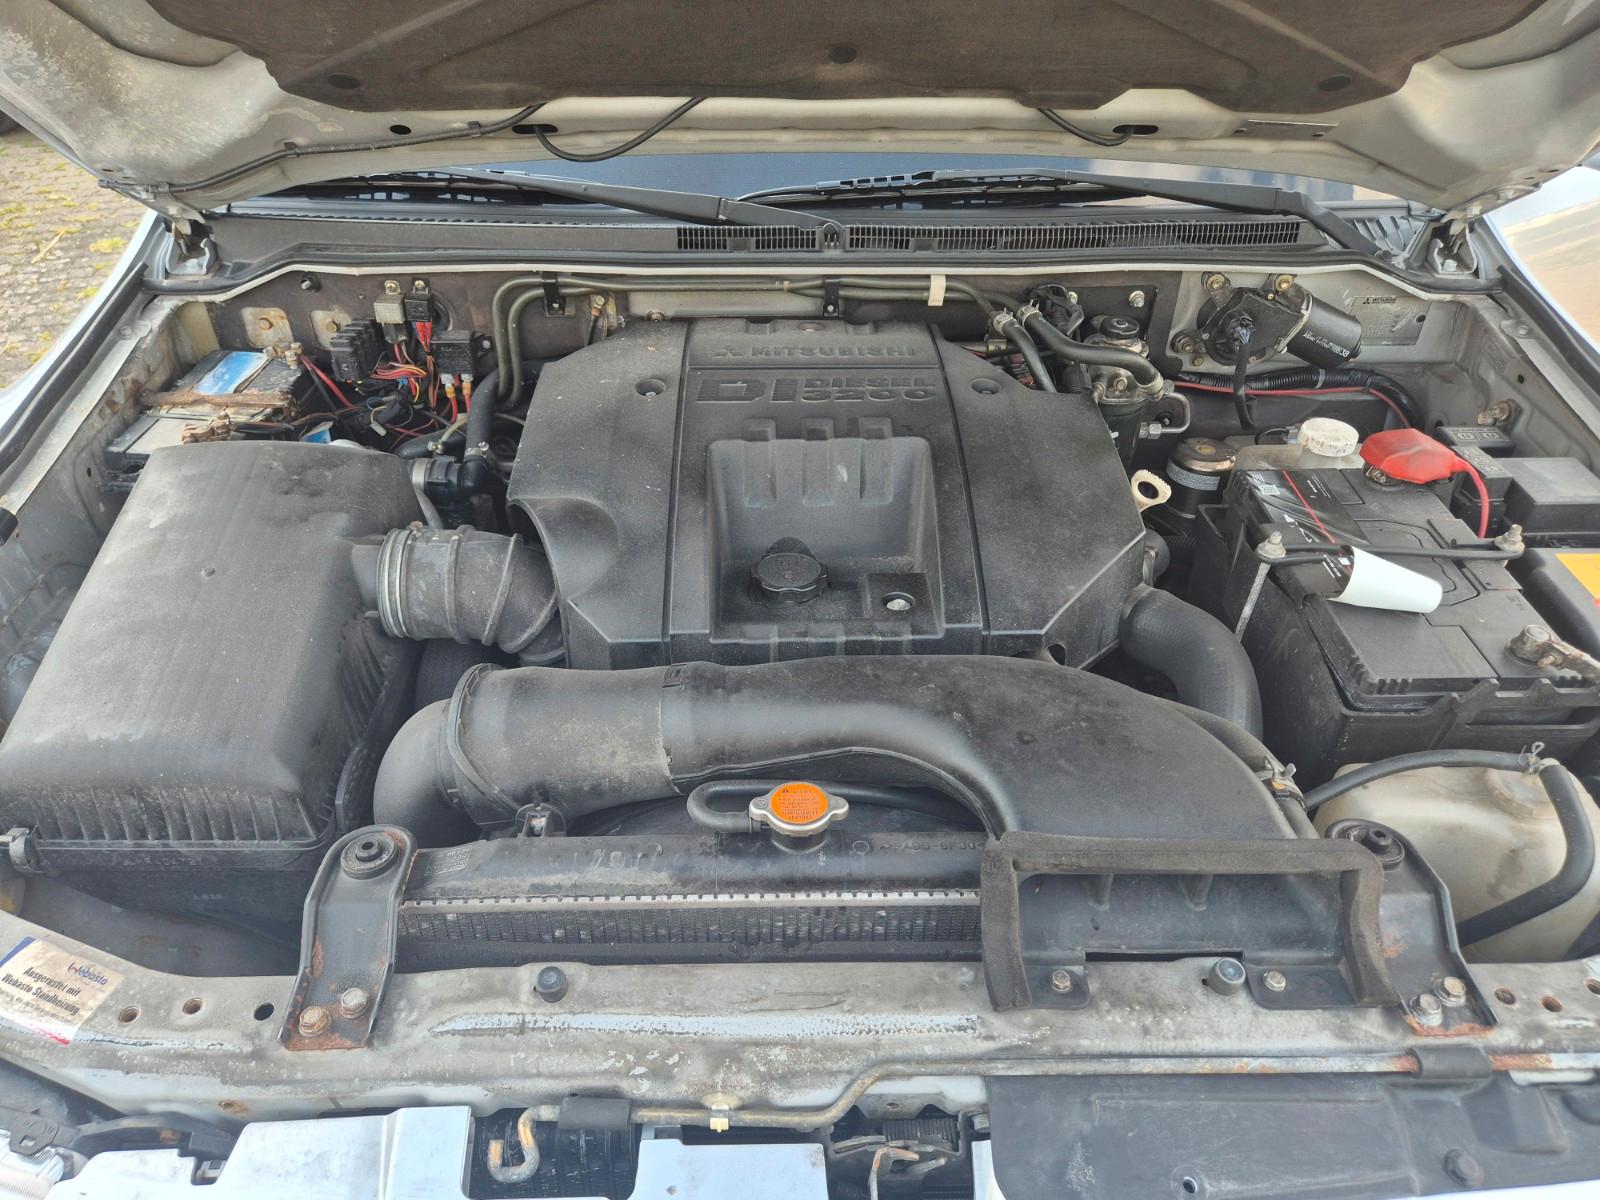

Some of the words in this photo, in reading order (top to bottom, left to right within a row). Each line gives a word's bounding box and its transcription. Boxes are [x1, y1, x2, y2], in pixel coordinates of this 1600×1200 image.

[751, 344, 916, 359] MITSUBISHI
[805, 375, 936, 389] DIESEL
[801, 389, 936, 403] 3200
[1, 972, 33, 993] Webasto
[31, 986, 81, 1016] Standheizung
[65, 984, 82, 998] mit
